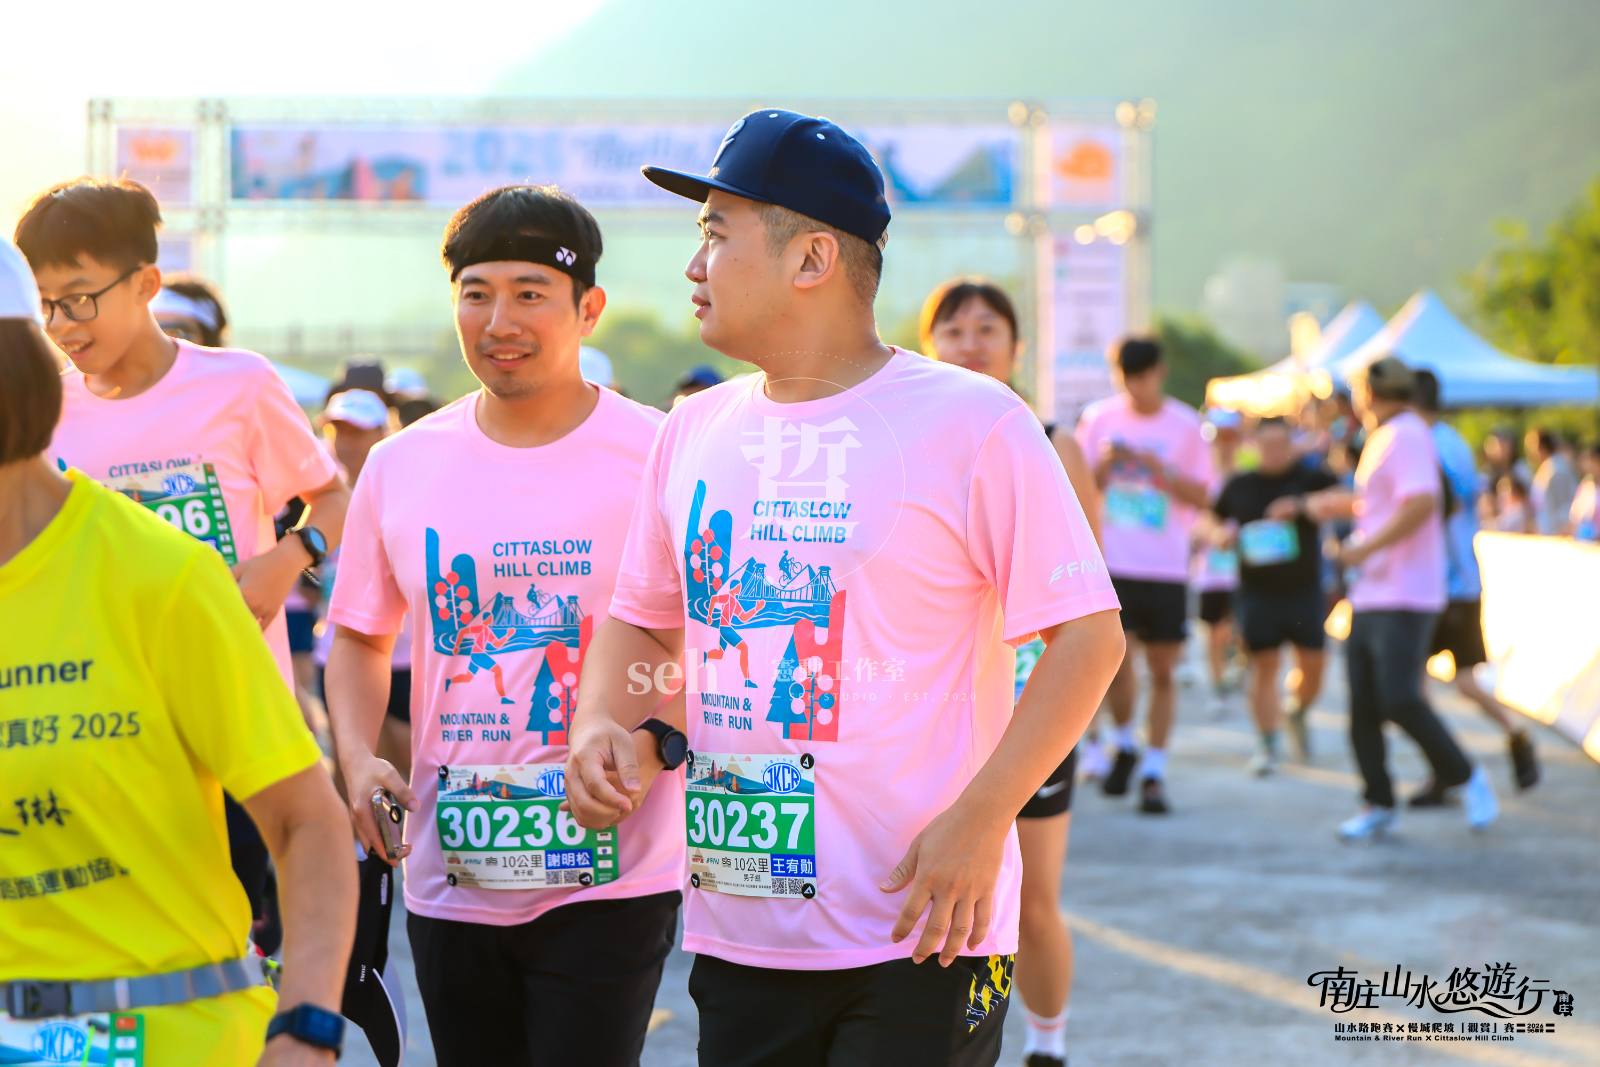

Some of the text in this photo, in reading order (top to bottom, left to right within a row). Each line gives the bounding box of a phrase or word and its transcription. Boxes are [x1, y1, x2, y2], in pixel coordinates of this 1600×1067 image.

[753, 500, 852, 519] CITTASLOW
[750, 523, 847, 543] HILL CLIMB
[493, 539, 592, 557] CITTASLOW
[494, 561, 592, 577] HILL CLIMB
[742, 697, 752, 712] &
[71, 711, 141, 740] 2025
[499, 713, 510, 725] &
[728, 715, 752, 731] RUN
[482, 730, 511, 742] RUN
[440, 805, 586, 848] 30236
[688, 797, 810, 850] 30237
[502, 854, 543, 868] 10公里
[735, 857, 770, 873] 10公里
